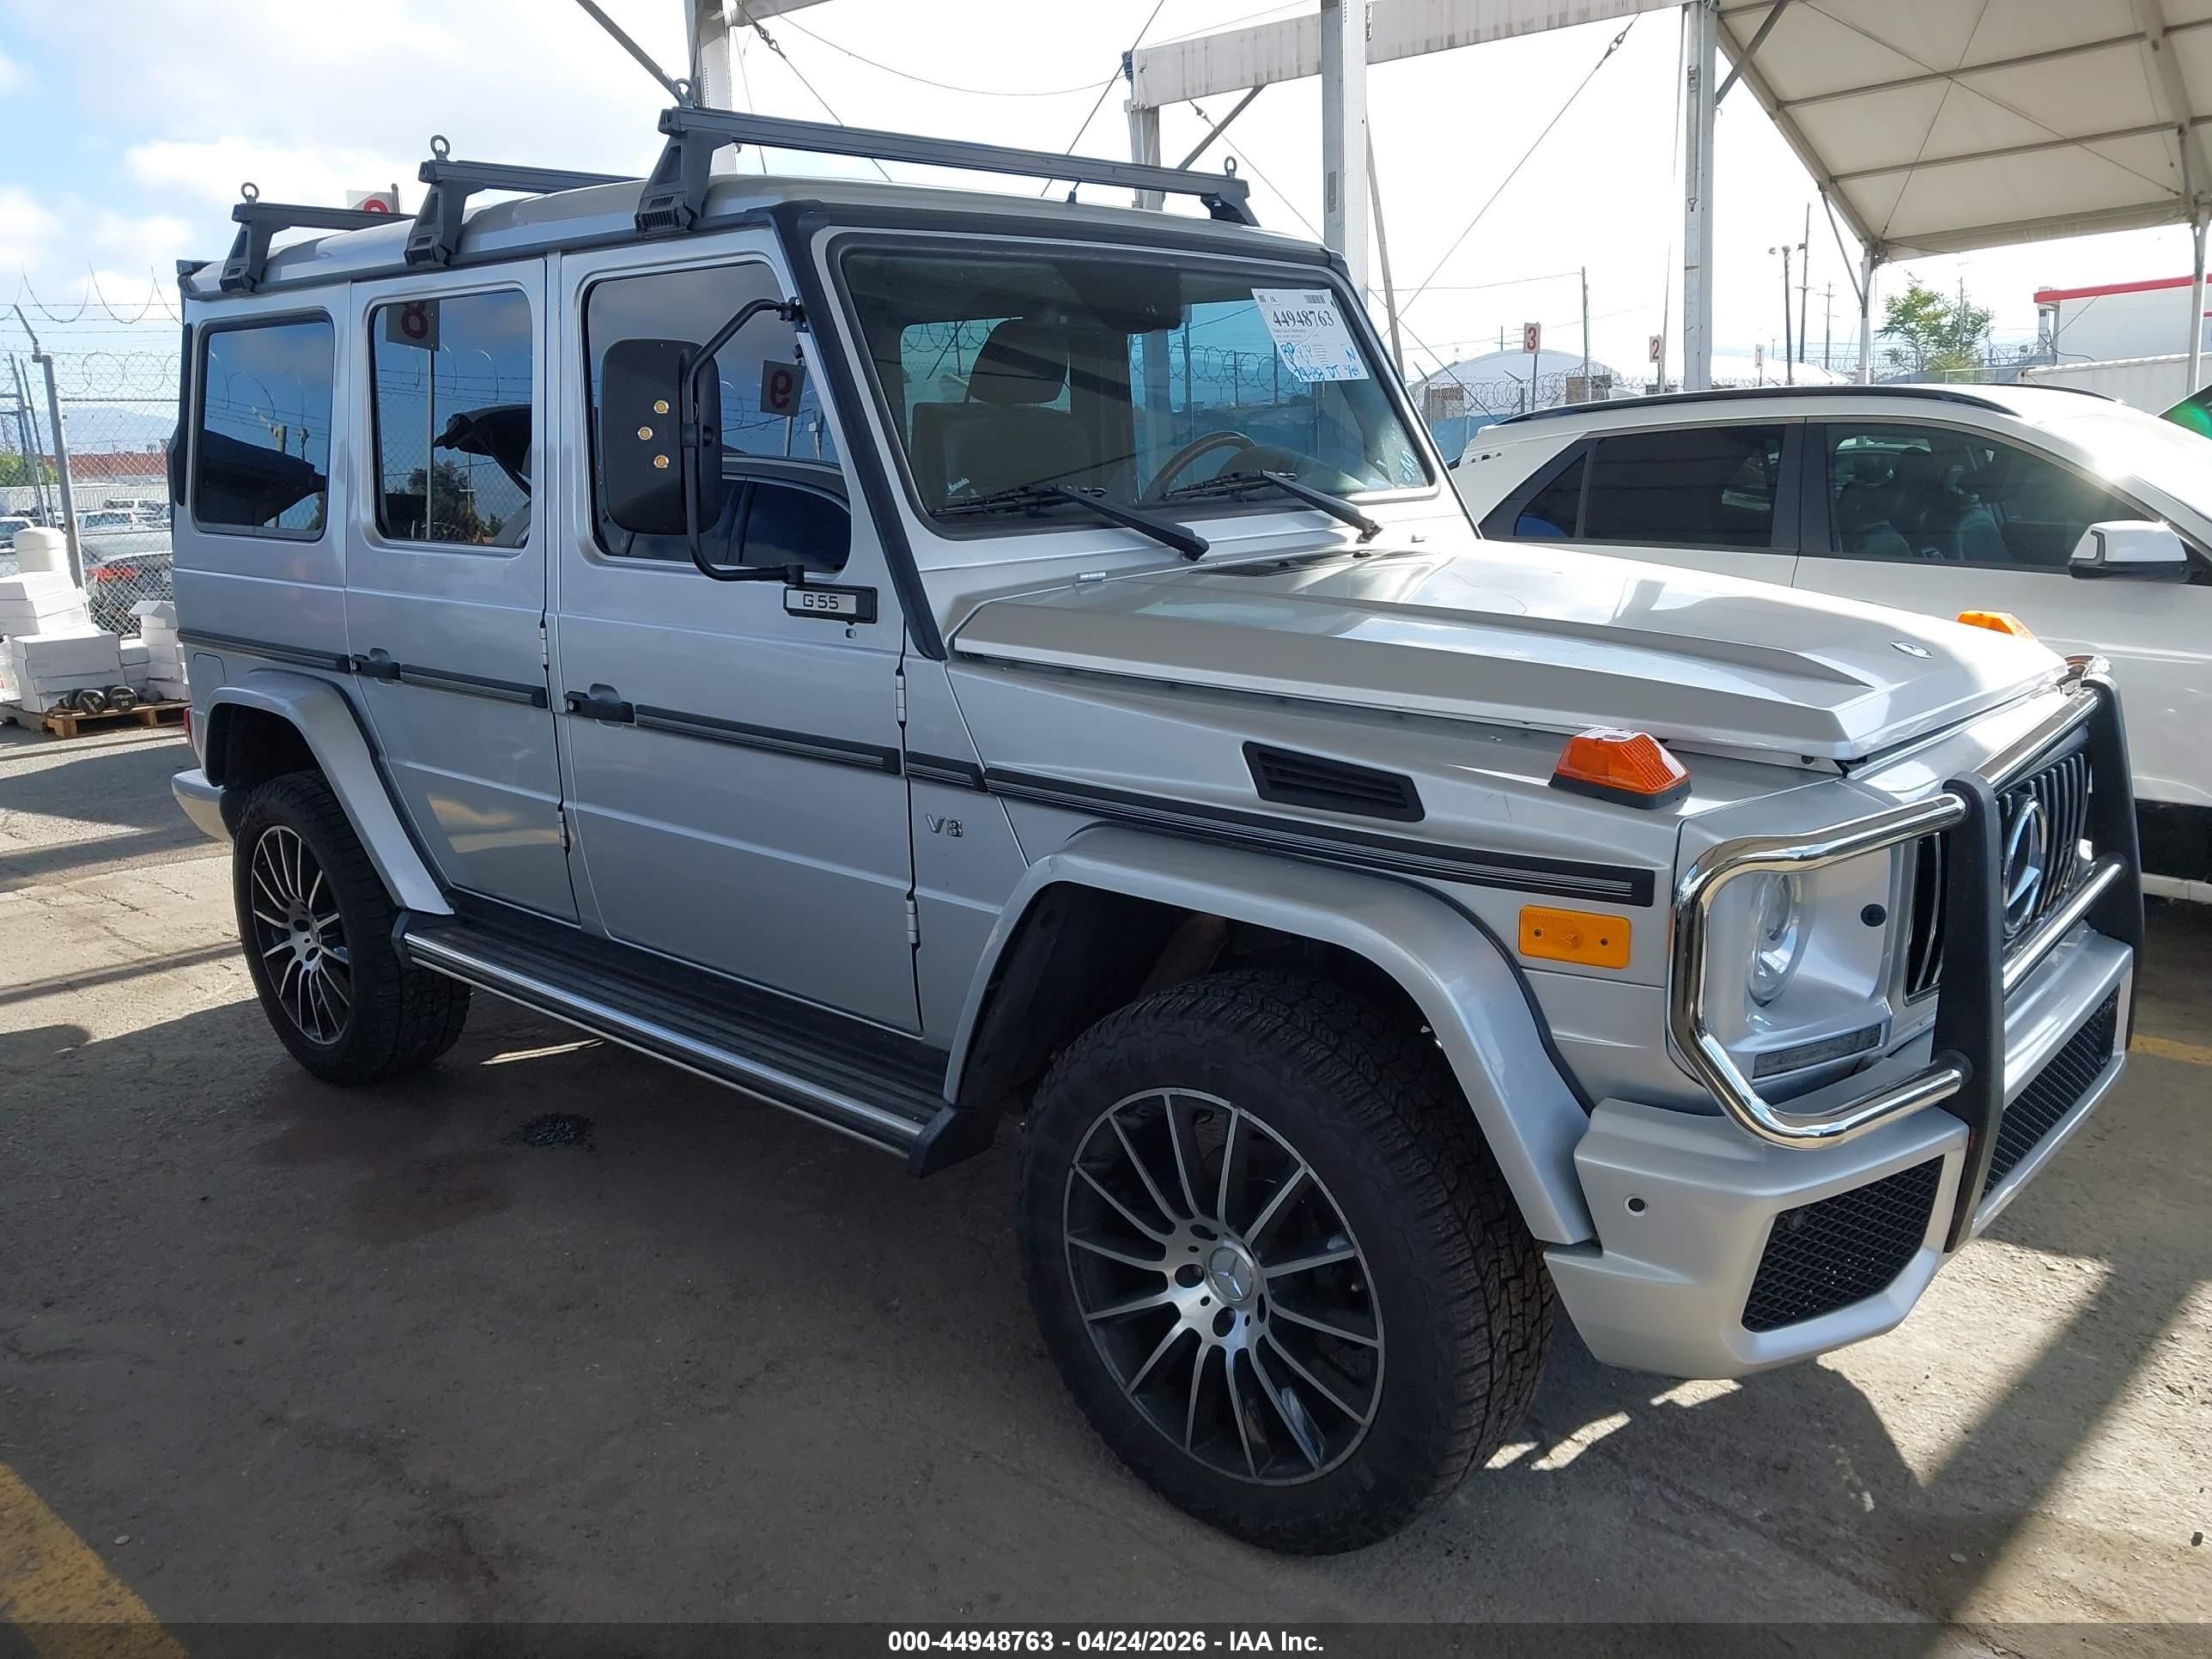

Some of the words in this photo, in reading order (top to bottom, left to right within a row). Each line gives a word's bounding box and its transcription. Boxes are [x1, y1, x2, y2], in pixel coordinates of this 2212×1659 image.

[1273, 309, 1334, 327] 44948763
[1528, 326, 1537, 351] 3
[1345, 347, 1356, 362] N
[1651, 338, 1660, 360] 2
[1757, 348, 1763, 367] 1
[926, 812, 963, 838] V8
